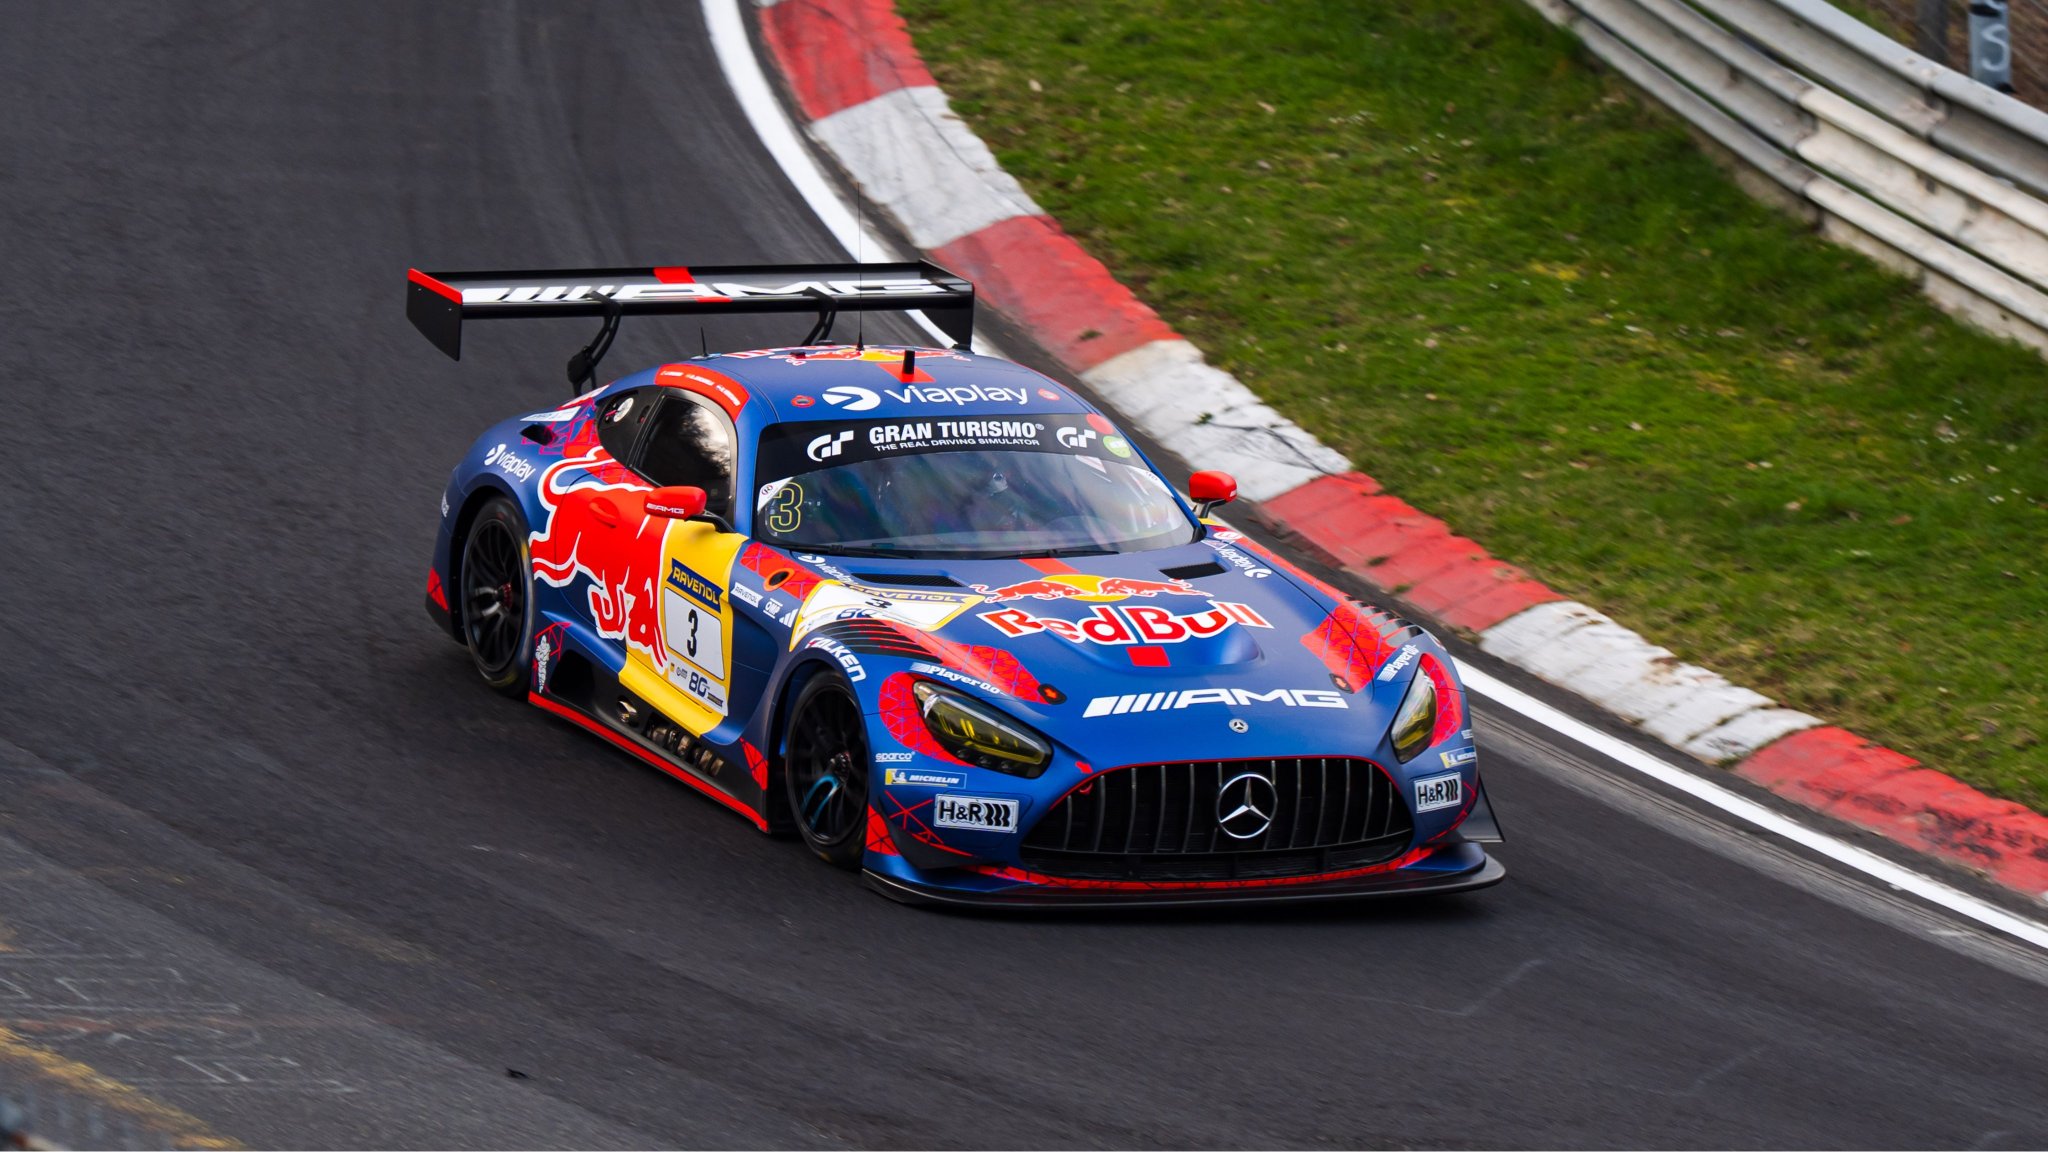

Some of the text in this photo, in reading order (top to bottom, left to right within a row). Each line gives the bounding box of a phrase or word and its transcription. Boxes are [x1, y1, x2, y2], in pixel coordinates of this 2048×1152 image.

[608, 279, 949, 301] AMG
[884, 383, 1028, 406] viaplay
[869, 422, 933, 445] GRAN
[874, 438, 1041, 452] THE REAL DRIVING SIMULATOR
[497, 452, 536, 483] viaplay
[769, 482, 804, 533] 3
[672, 566, 720, 605] RAVENOL
[735, 586, 758, 604] RAVENOL
[865, 597, 893, 609] 3
[686, 608, 698, 658] 3
[976, 599, 1275, 646] Red Bull
[806, 637, 867, 682] FALKEN
[875, 752, 912, 763] sparco
[909, 774, 960, 785] MICHELIN
[1416, 782, 1445, 805] H&R
[938, 800, 982, 823] H&R
